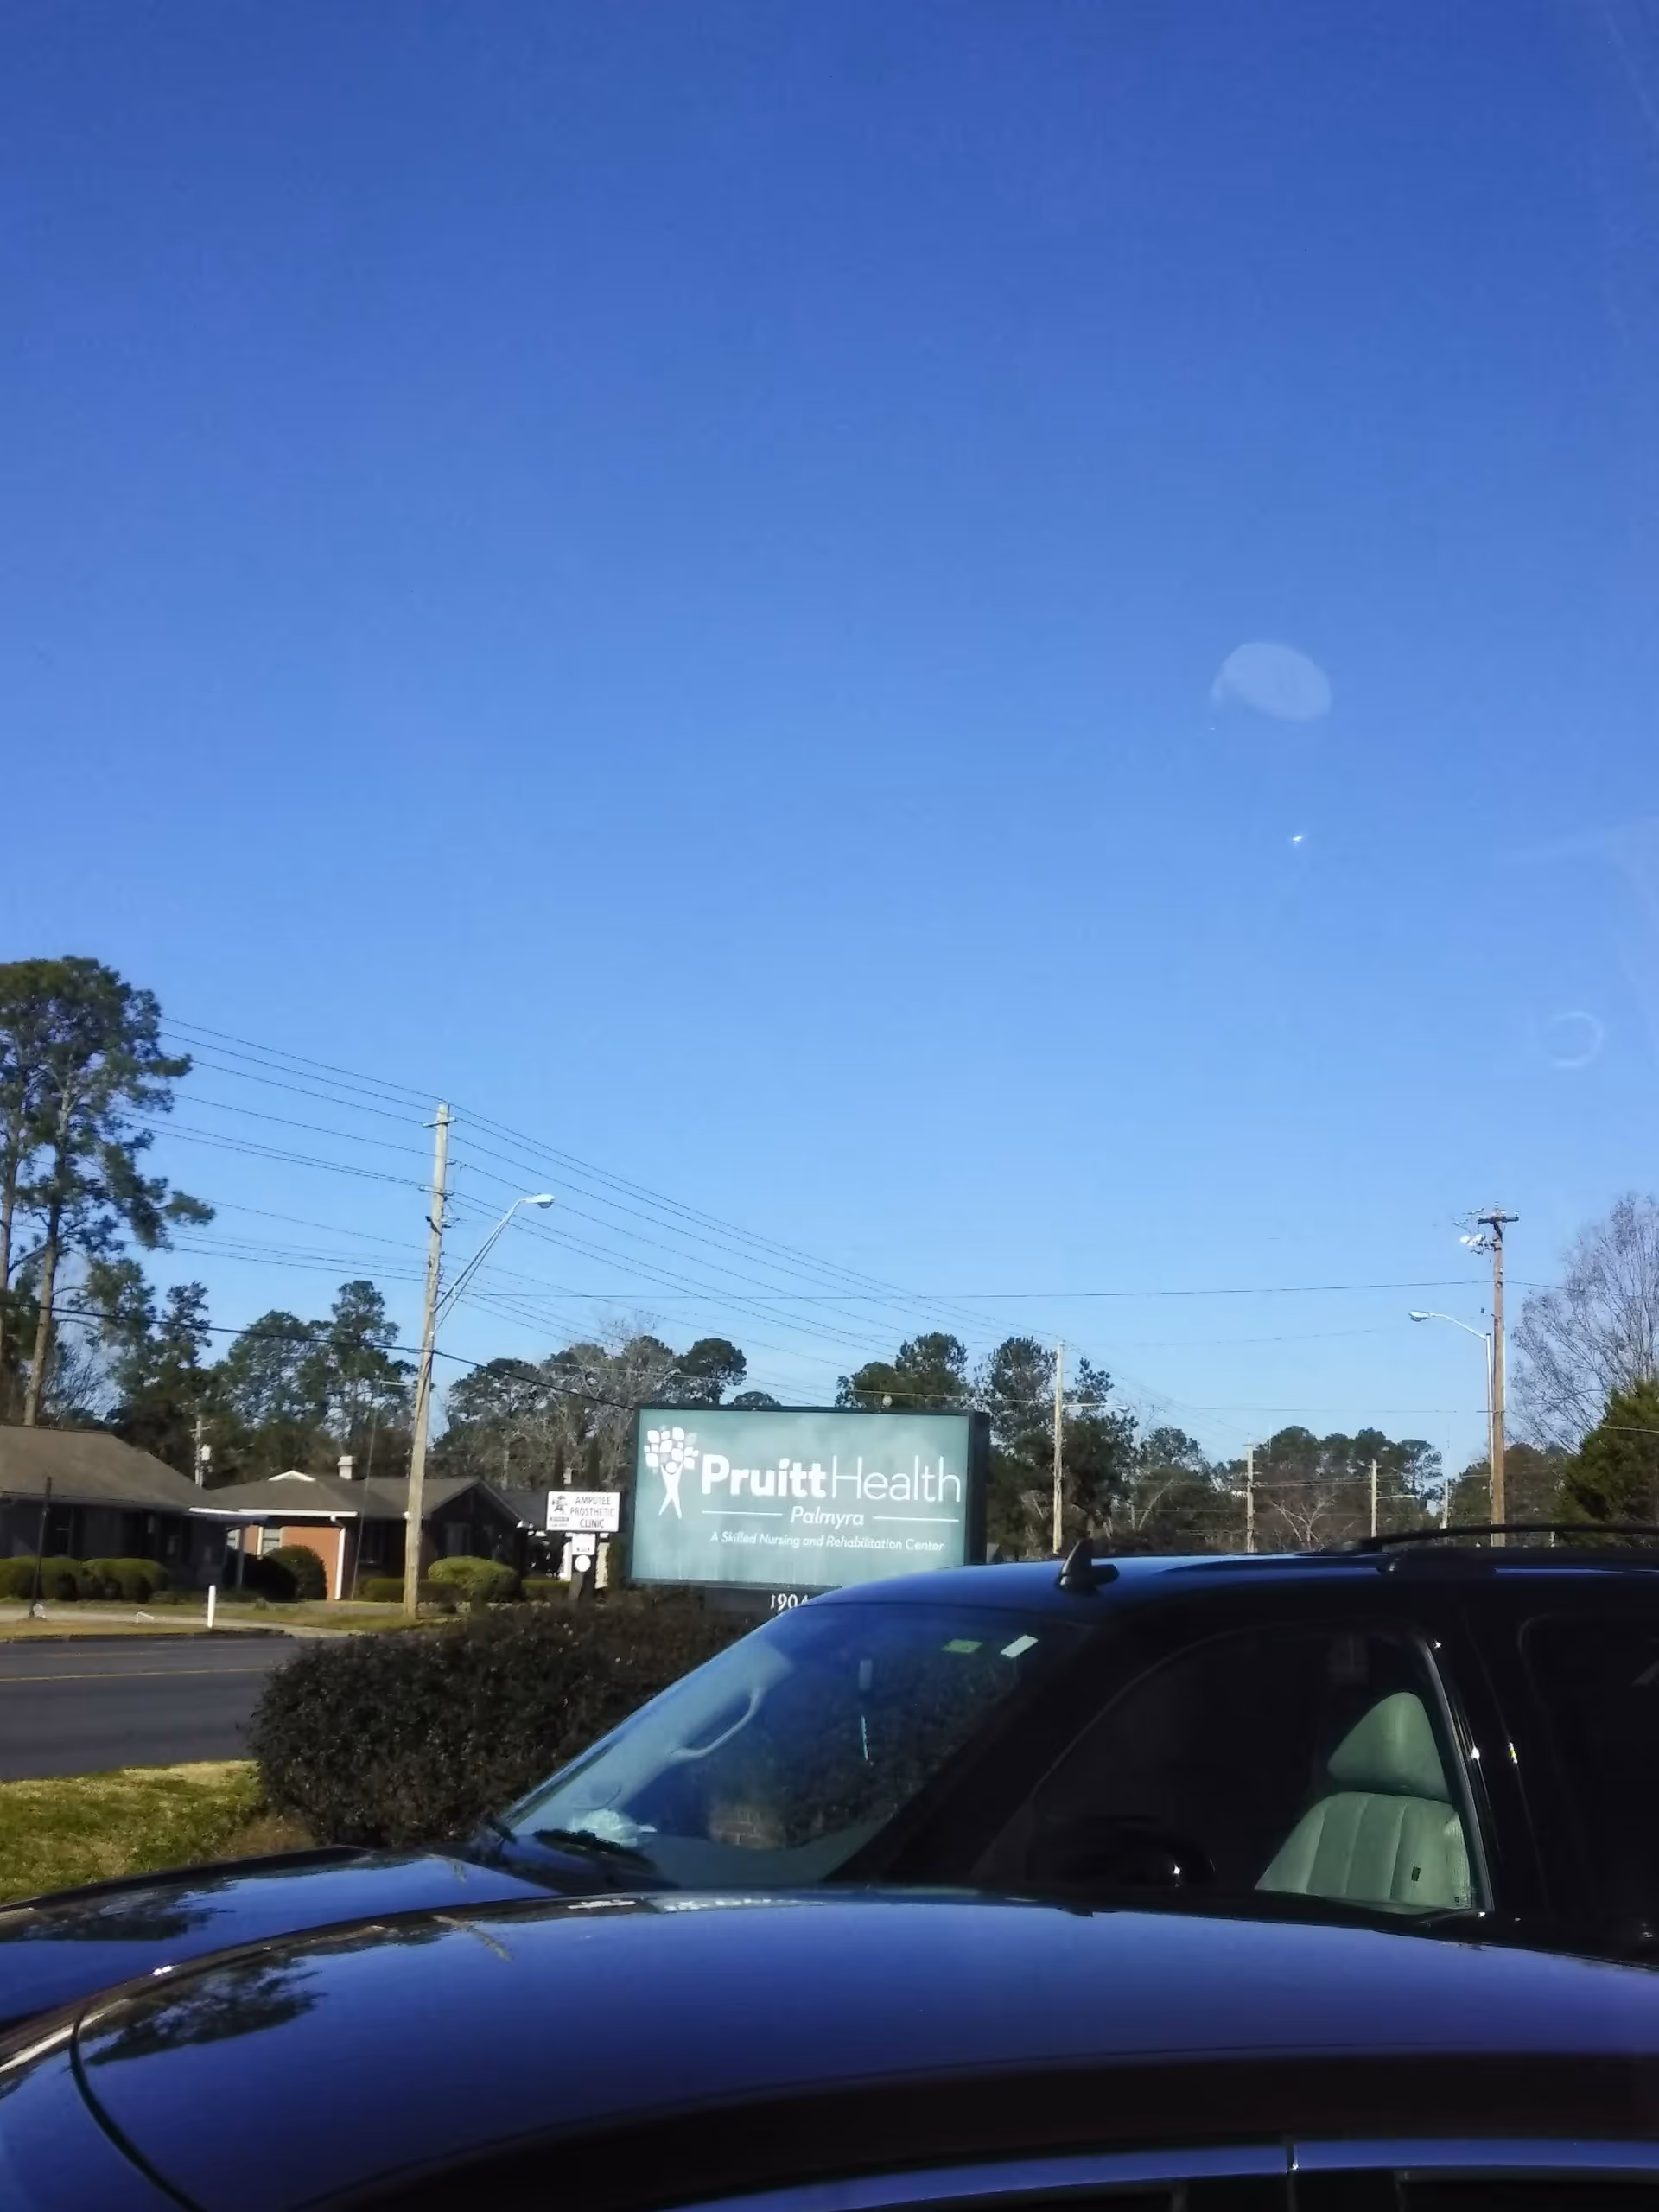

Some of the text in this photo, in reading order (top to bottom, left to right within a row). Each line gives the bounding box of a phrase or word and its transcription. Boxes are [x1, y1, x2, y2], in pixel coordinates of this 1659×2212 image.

[575, 1497, 611, 1505] AMPUTEE
[580, 1519, 604, 1528] CLINIC
[790, 1506, 864, 1529] Palmyra
[710, 1531, 944, 1550] A Skilled Nursing and Rehabilitation Center
